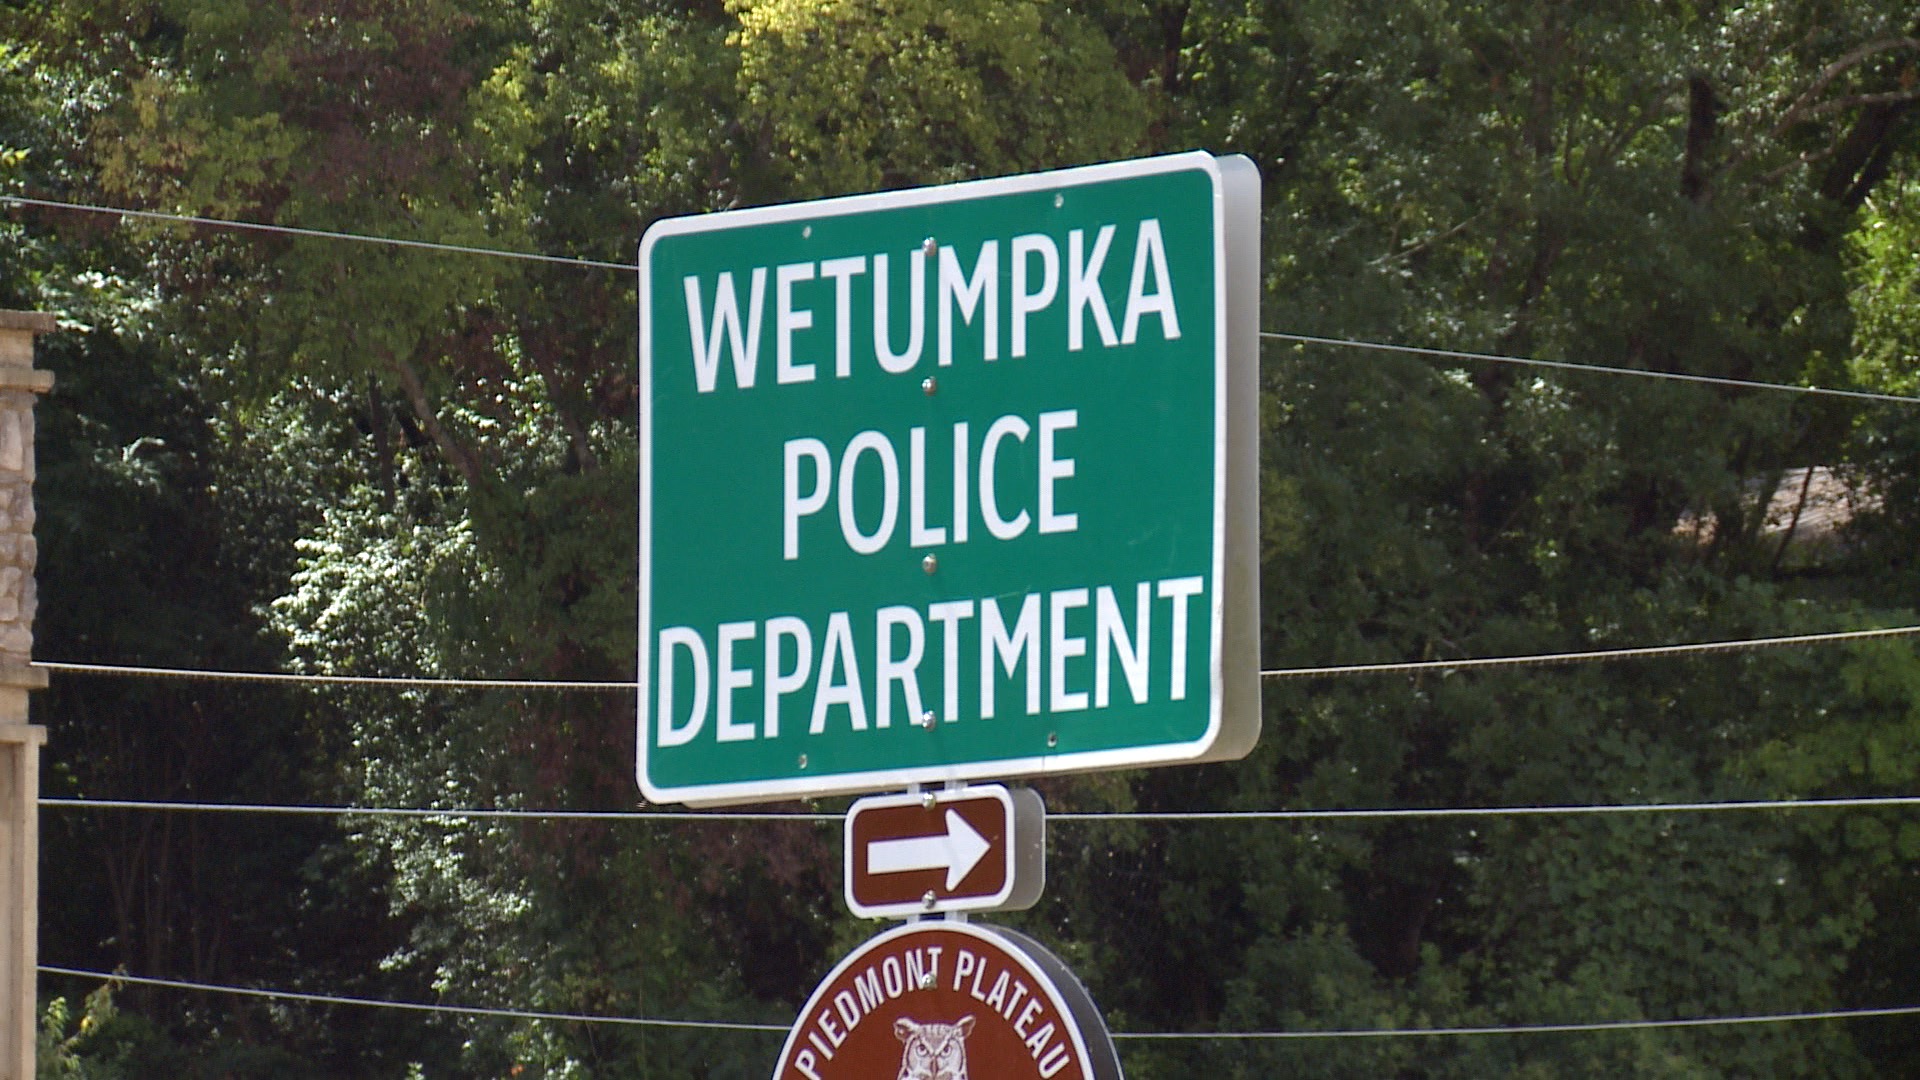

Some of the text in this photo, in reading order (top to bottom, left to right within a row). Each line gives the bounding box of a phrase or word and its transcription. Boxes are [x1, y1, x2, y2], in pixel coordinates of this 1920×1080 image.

[683, 218, 1182, 394] WETUMPKA
[783, 409, 1078, 560] POLICE
[657, 576, 1203, 747] DEPARTMENT
[794, 946, 1070, 1080] PIEDMONT PLATEAU
